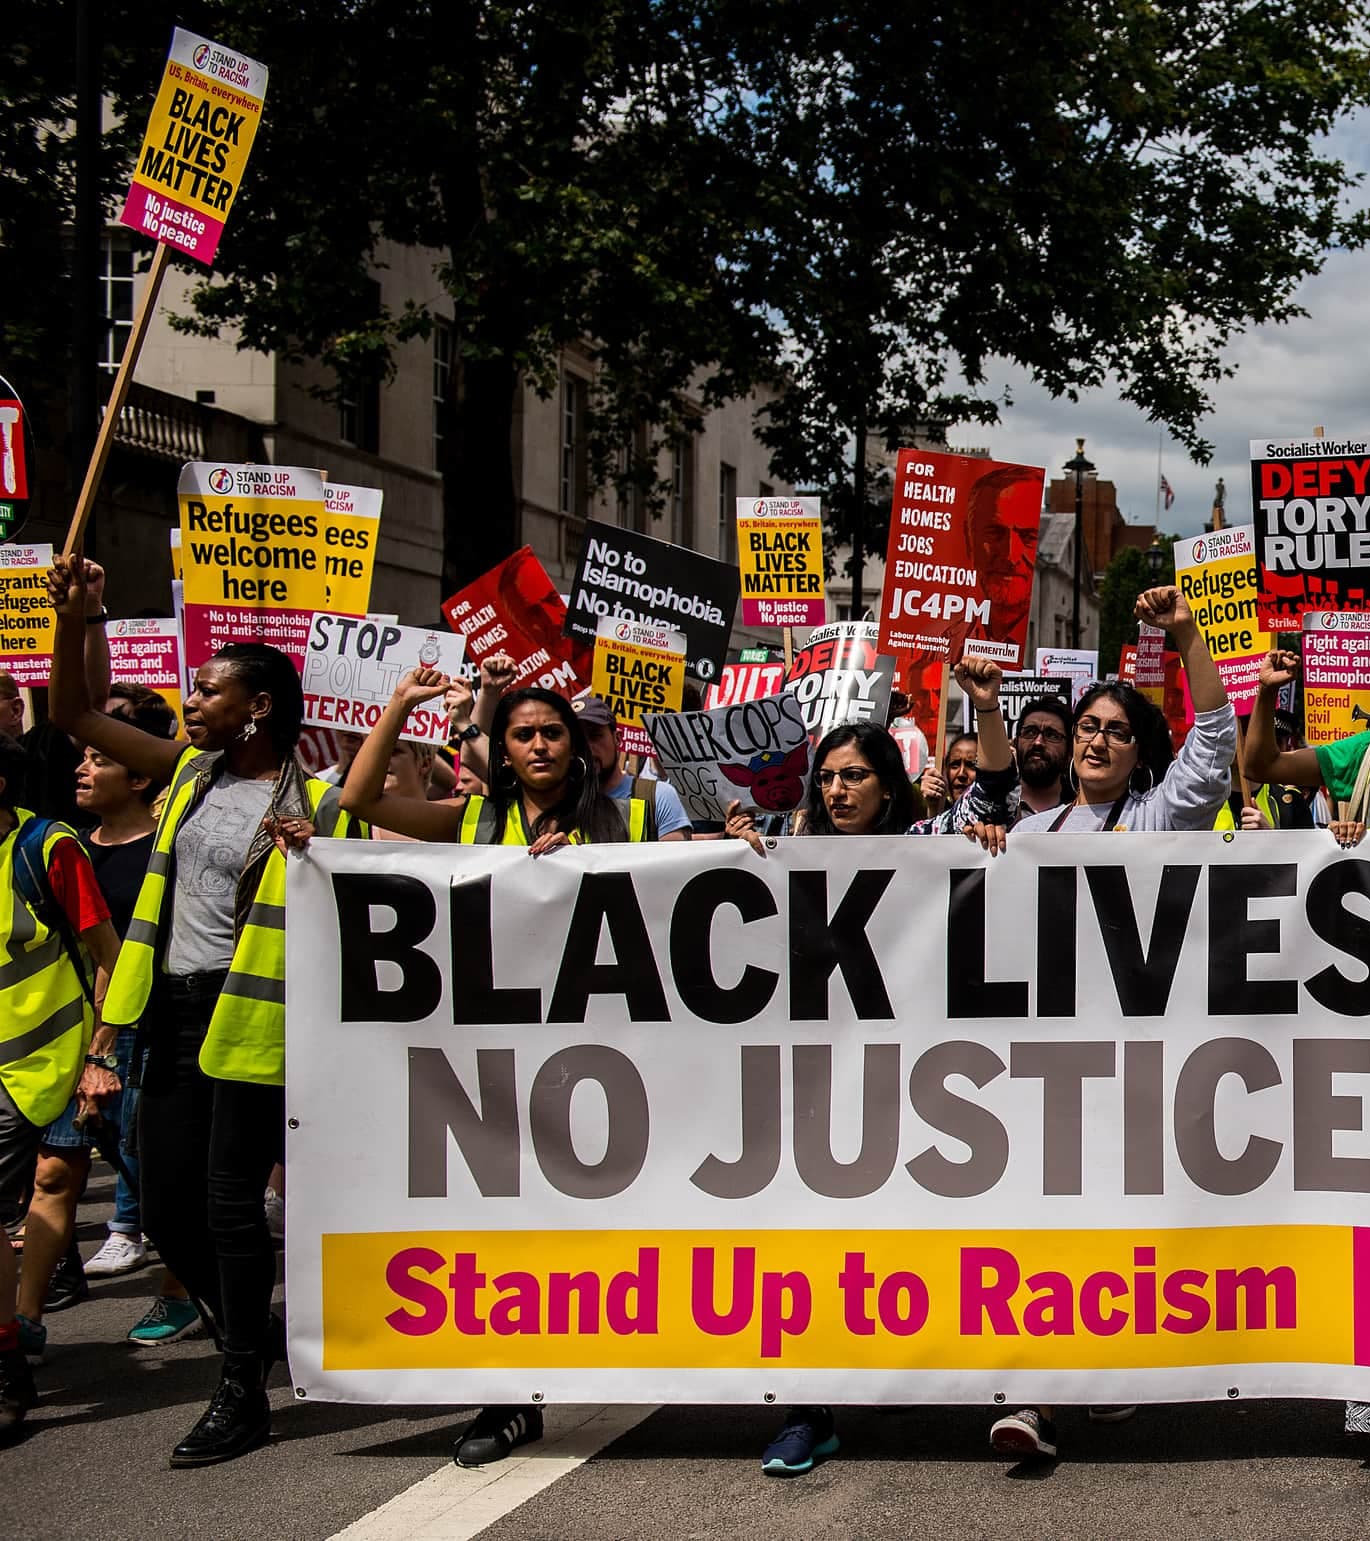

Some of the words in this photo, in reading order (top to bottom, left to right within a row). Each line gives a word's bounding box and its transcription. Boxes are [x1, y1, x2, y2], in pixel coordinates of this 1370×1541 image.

[208, 60, 217, 75] TO
[218, 66, 250, 89] RACISM
[211, 51, 236, 69] STAND
[237, 62, 249, 74] UP
[169, 63, 183, 80] US,
[184, 71, 209, 94] Britain,
[211, 85, 259, 113] everywhere
[168, 88, 246, 146] BLACK
[163, 122, 228, 173] LIVES
[140, 147, 233, 212] MATTER
[145, 193, 161, 214] No
[159, 200, 205, 235] justice
[143, 211, 158, 233] No
[158, 220, 197, 250] peace
[1266, 443, 1321, 458] Socialist
[1321, 441, 1367, 455] Worker
[236, 471, 271, 483] STAND
[275, 473, 290, 484] UP
[906, 462, 934, 477] FOR
[236, 484, 250, 494] TO
[254, 485, 296, 496] RACISM
[904, 481, 955, 504] HEALTH
[187, 502, 318, 542] Refugees
[901, 508, 951, 531] HOMES
[191, 537, 316, 570] welcome
[750, 532, 811, 552] BLACK
[898, 534, 934, 555] JOBS
[587, 538, 620, 567] No
[624, 553, 646, 576] to
[755, 553, 807, 573] LIVES
[223, 570, 287, 601] here
[744, 574, 820, 593] MATTER
[895, 560, 977, 587] EDUCATION
[576, 588, 609, 617] No
[582, 561, 727, 627] Islamophobia.
[889, 588, 991, 624] JC4PM
[209, 611, 224, 622] No
[226, 612, 237, 623] to
[240, 610, 310, 626] Islamophobia
[450, 600, 472, 620] FOR
[458, 604, 497, 635] HEALTH
[758, 601, 771, 612] No
[773, 601, 809, 615] justice
[761, 612, 774, 623] No
[776, 613, 807, 625] peace
[1, 635, 37, 649] here
[210, 625, 229, 635] and
[232, 624, 306, 638] anti-Semitism
[310, 616, 401, 661] STOP
[470, 623, 509, 656] HOMES
[890, 630, 914, 642] Labour
[915, 633, 950, 646] Assembly
[1206, 629, 1253, 655] here
[1305, 634, 1338, 652] Fight
[888, 639, 912, 651] Against
[912, 642, 950, 654] Austerity
[967, 643, 1016, 658] MOMENTUM
[1305, 652, 1348, 667] racism
[606, 653, 672, 686] BLACK
[609, 676, 665, 705] LIVES
[1307, 693, 1350, 708] Defend
[303, 694, 450, 741] TERROISM
[640, 710, 731, 764] KILLER
[726, 693, 807, 754] COPS
[1307, 710, 1330, 724] civil
[664, 765, 718, 797] JOG
[332, 866, 896, 1025] BLACK
[407, 1044, 650, 1200] NO
[384, 1246, 660, 1337] Stand
[690, 1246, 811, 1358] Up
[839, 1252, 929, 1337] to
[960, 1246, 1297, 1337] Racism
